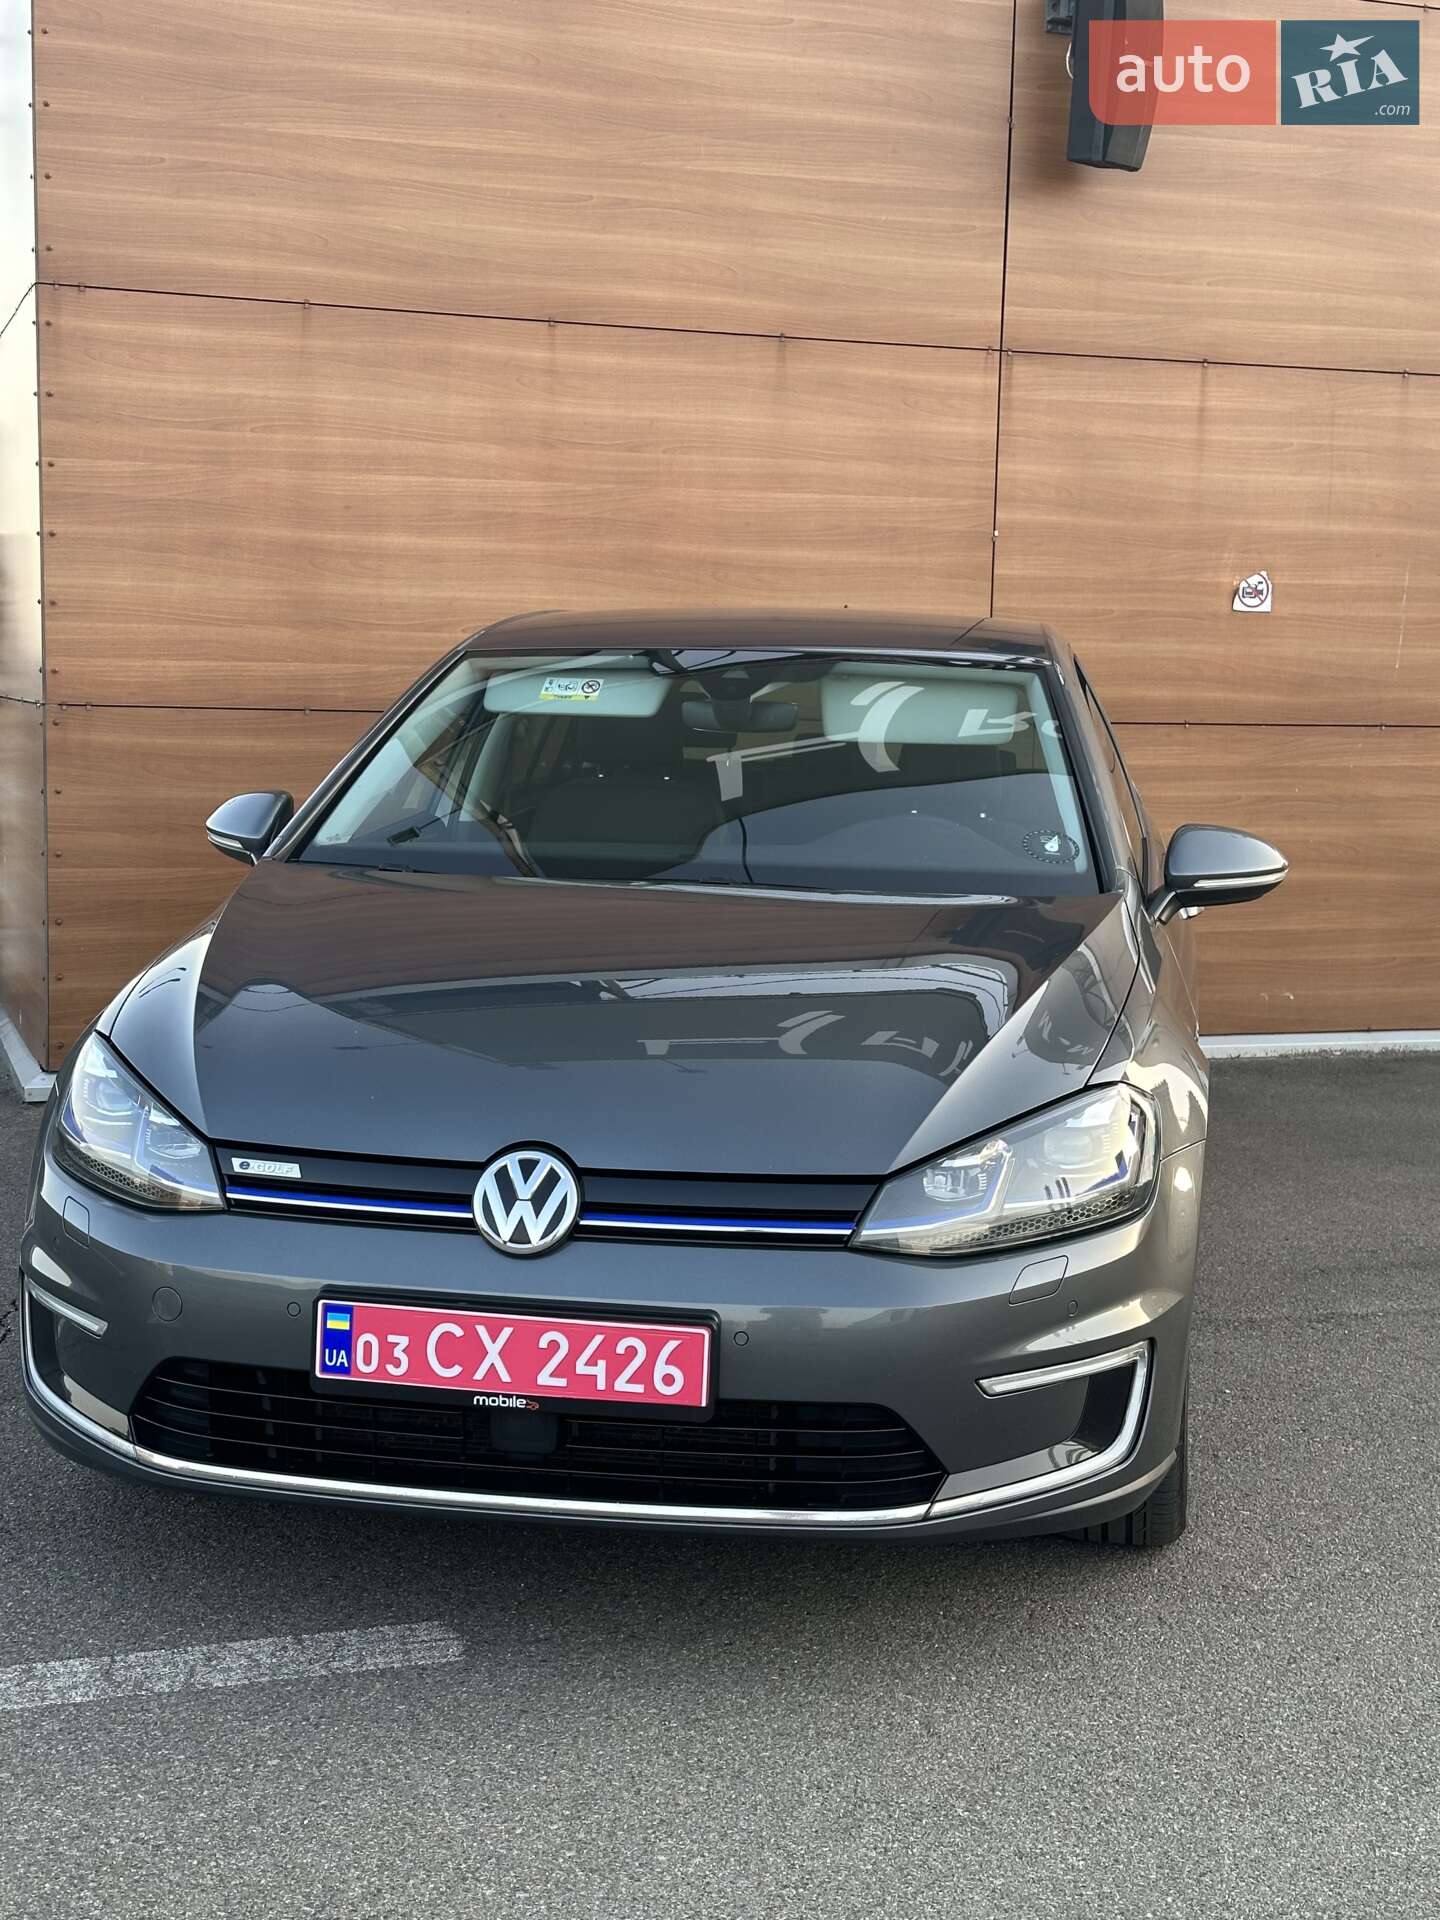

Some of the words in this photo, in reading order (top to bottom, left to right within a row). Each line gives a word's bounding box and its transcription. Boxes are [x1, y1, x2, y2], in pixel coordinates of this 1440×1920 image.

[325, 1347, 349, 1368] UA
[355, 1332, 410, 1376] 03
[426, 1322, 514, 1383] CX
[536, 1330, 685, 1396] 2426
[473, 1394, 527, 1408] mobile
